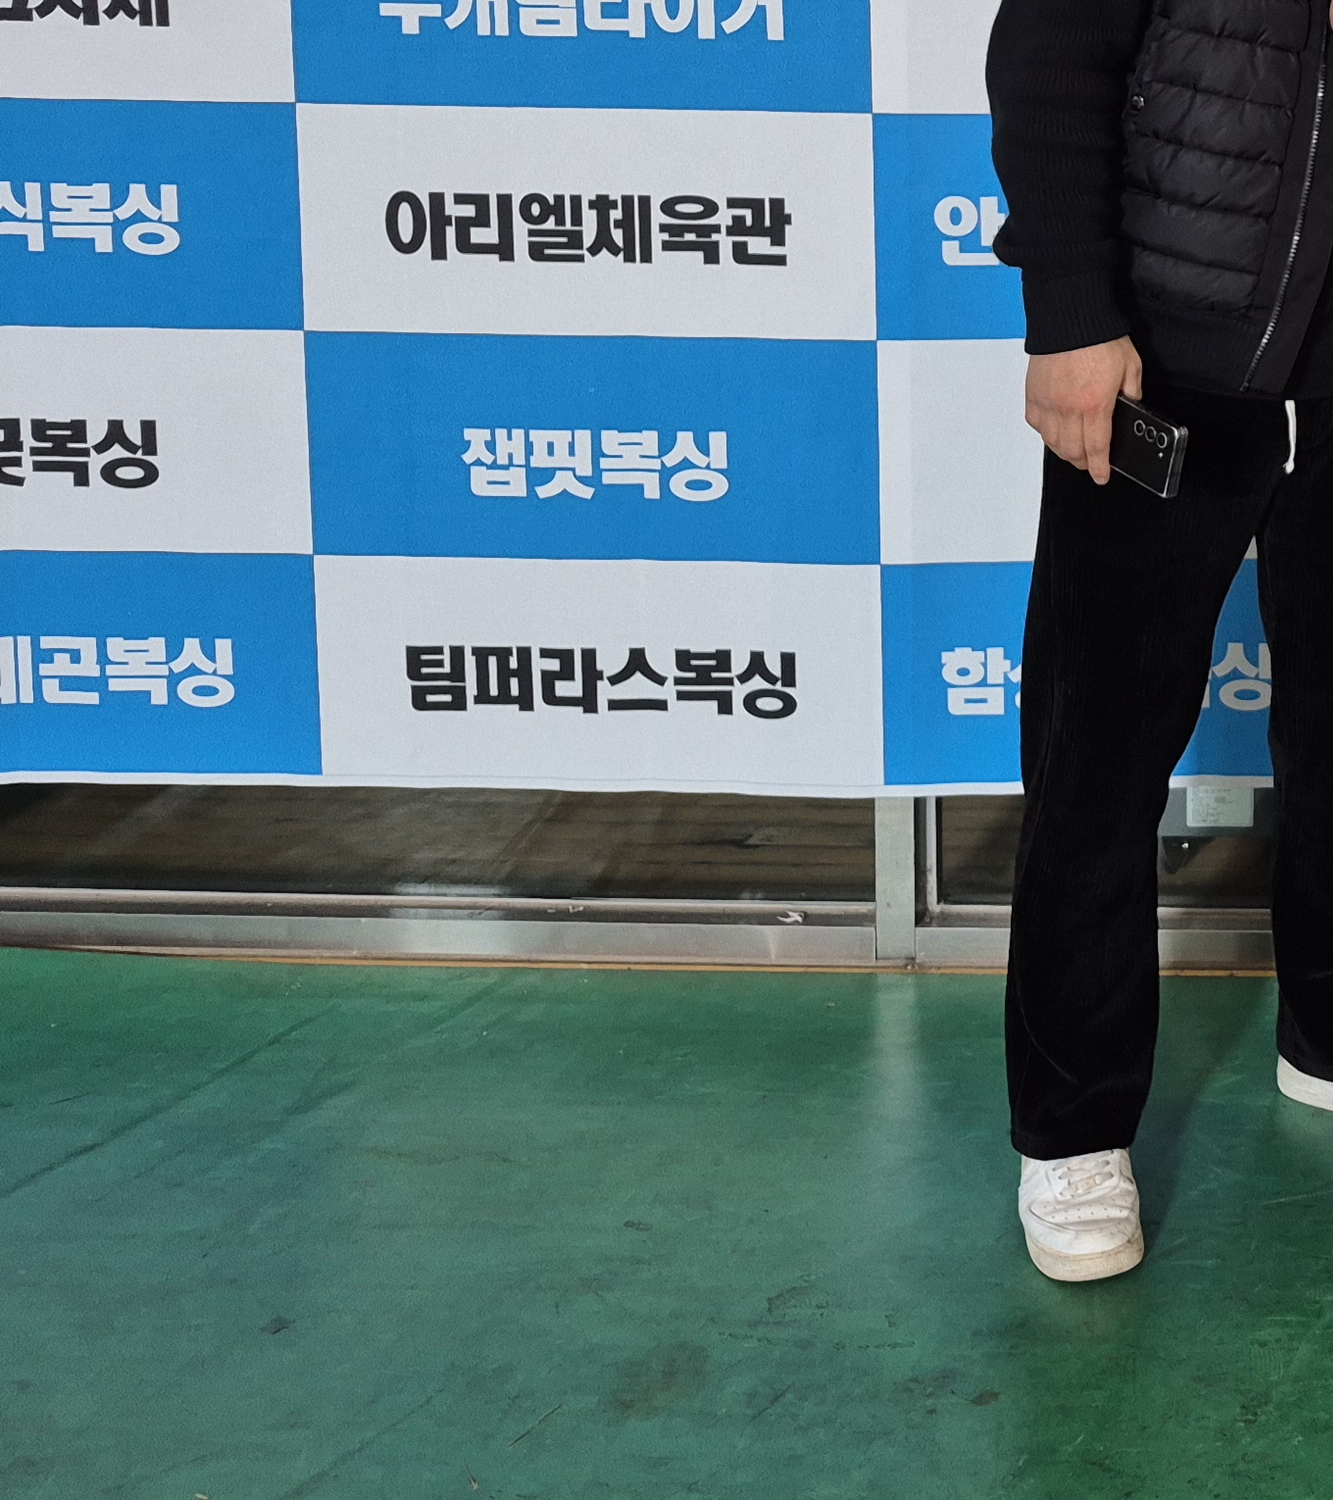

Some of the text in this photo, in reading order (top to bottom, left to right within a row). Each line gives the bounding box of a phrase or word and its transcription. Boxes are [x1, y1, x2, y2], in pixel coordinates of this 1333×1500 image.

[385, 190, 792, 266] 아리엘체육관
[461, 426, 729, 501] 잽핏복싱
[405, 644, 798, 719] 팀퍼라스복싱
